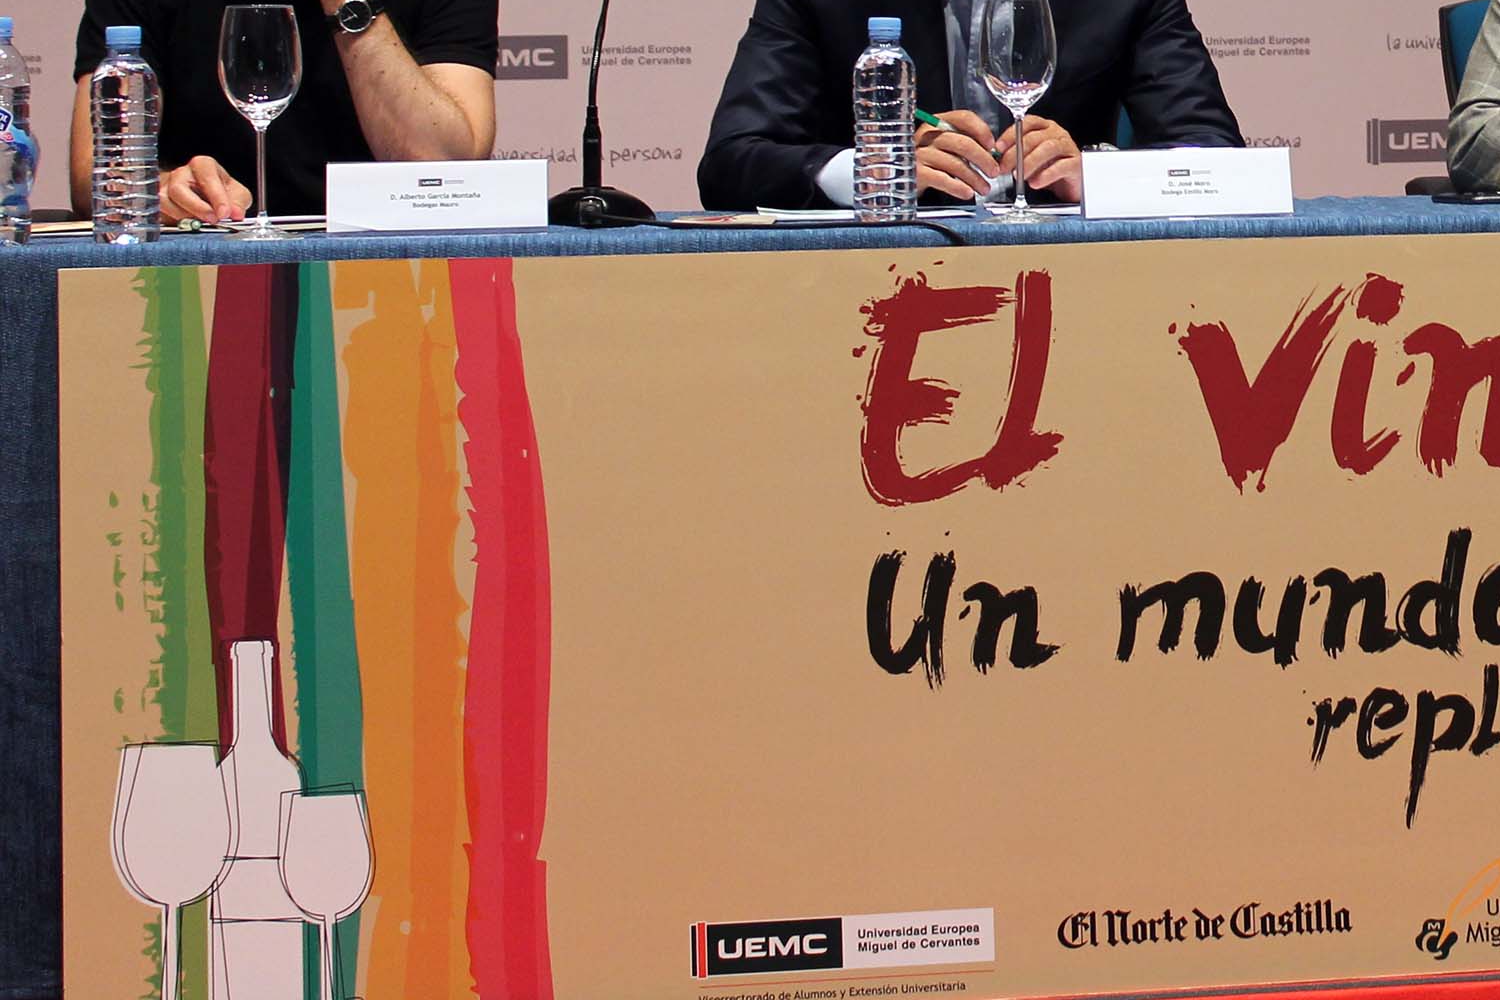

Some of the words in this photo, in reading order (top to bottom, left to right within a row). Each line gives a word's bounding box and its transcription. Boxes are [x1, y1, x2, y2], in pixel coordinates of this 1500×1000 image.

[1204, 36, 1265, 47] Universidad
[1269, 36, 1310, 46] Europea
[610, 147, 682, 168] persona
[852, 262, 1065, 506] El
[866, 545, 1064, 692] Un
[858, 926, 928, 938] Universidad
[932, 925, 979, 935] Europea
[1058, 911, 1099, 949] El
[1102, 909, 1188, 947] Norte
[1192, 908, 1225, 940] de
[1230, 899, 1352, 939] Castilla
[718, 934, 827, 959] UEMC
[858, 941, 897, 953] Miguel
[902, 940, 916, 949] de
[921, 937, 980, 948] Cervantes
[778, 990, 791, 1000] de
[794, 990, 836, 1000] Alumnos
[840, 990, 846, 1000] y
[849, 984, 898, 996] Extensión
[901, 981, 965, 993] Universitaria
